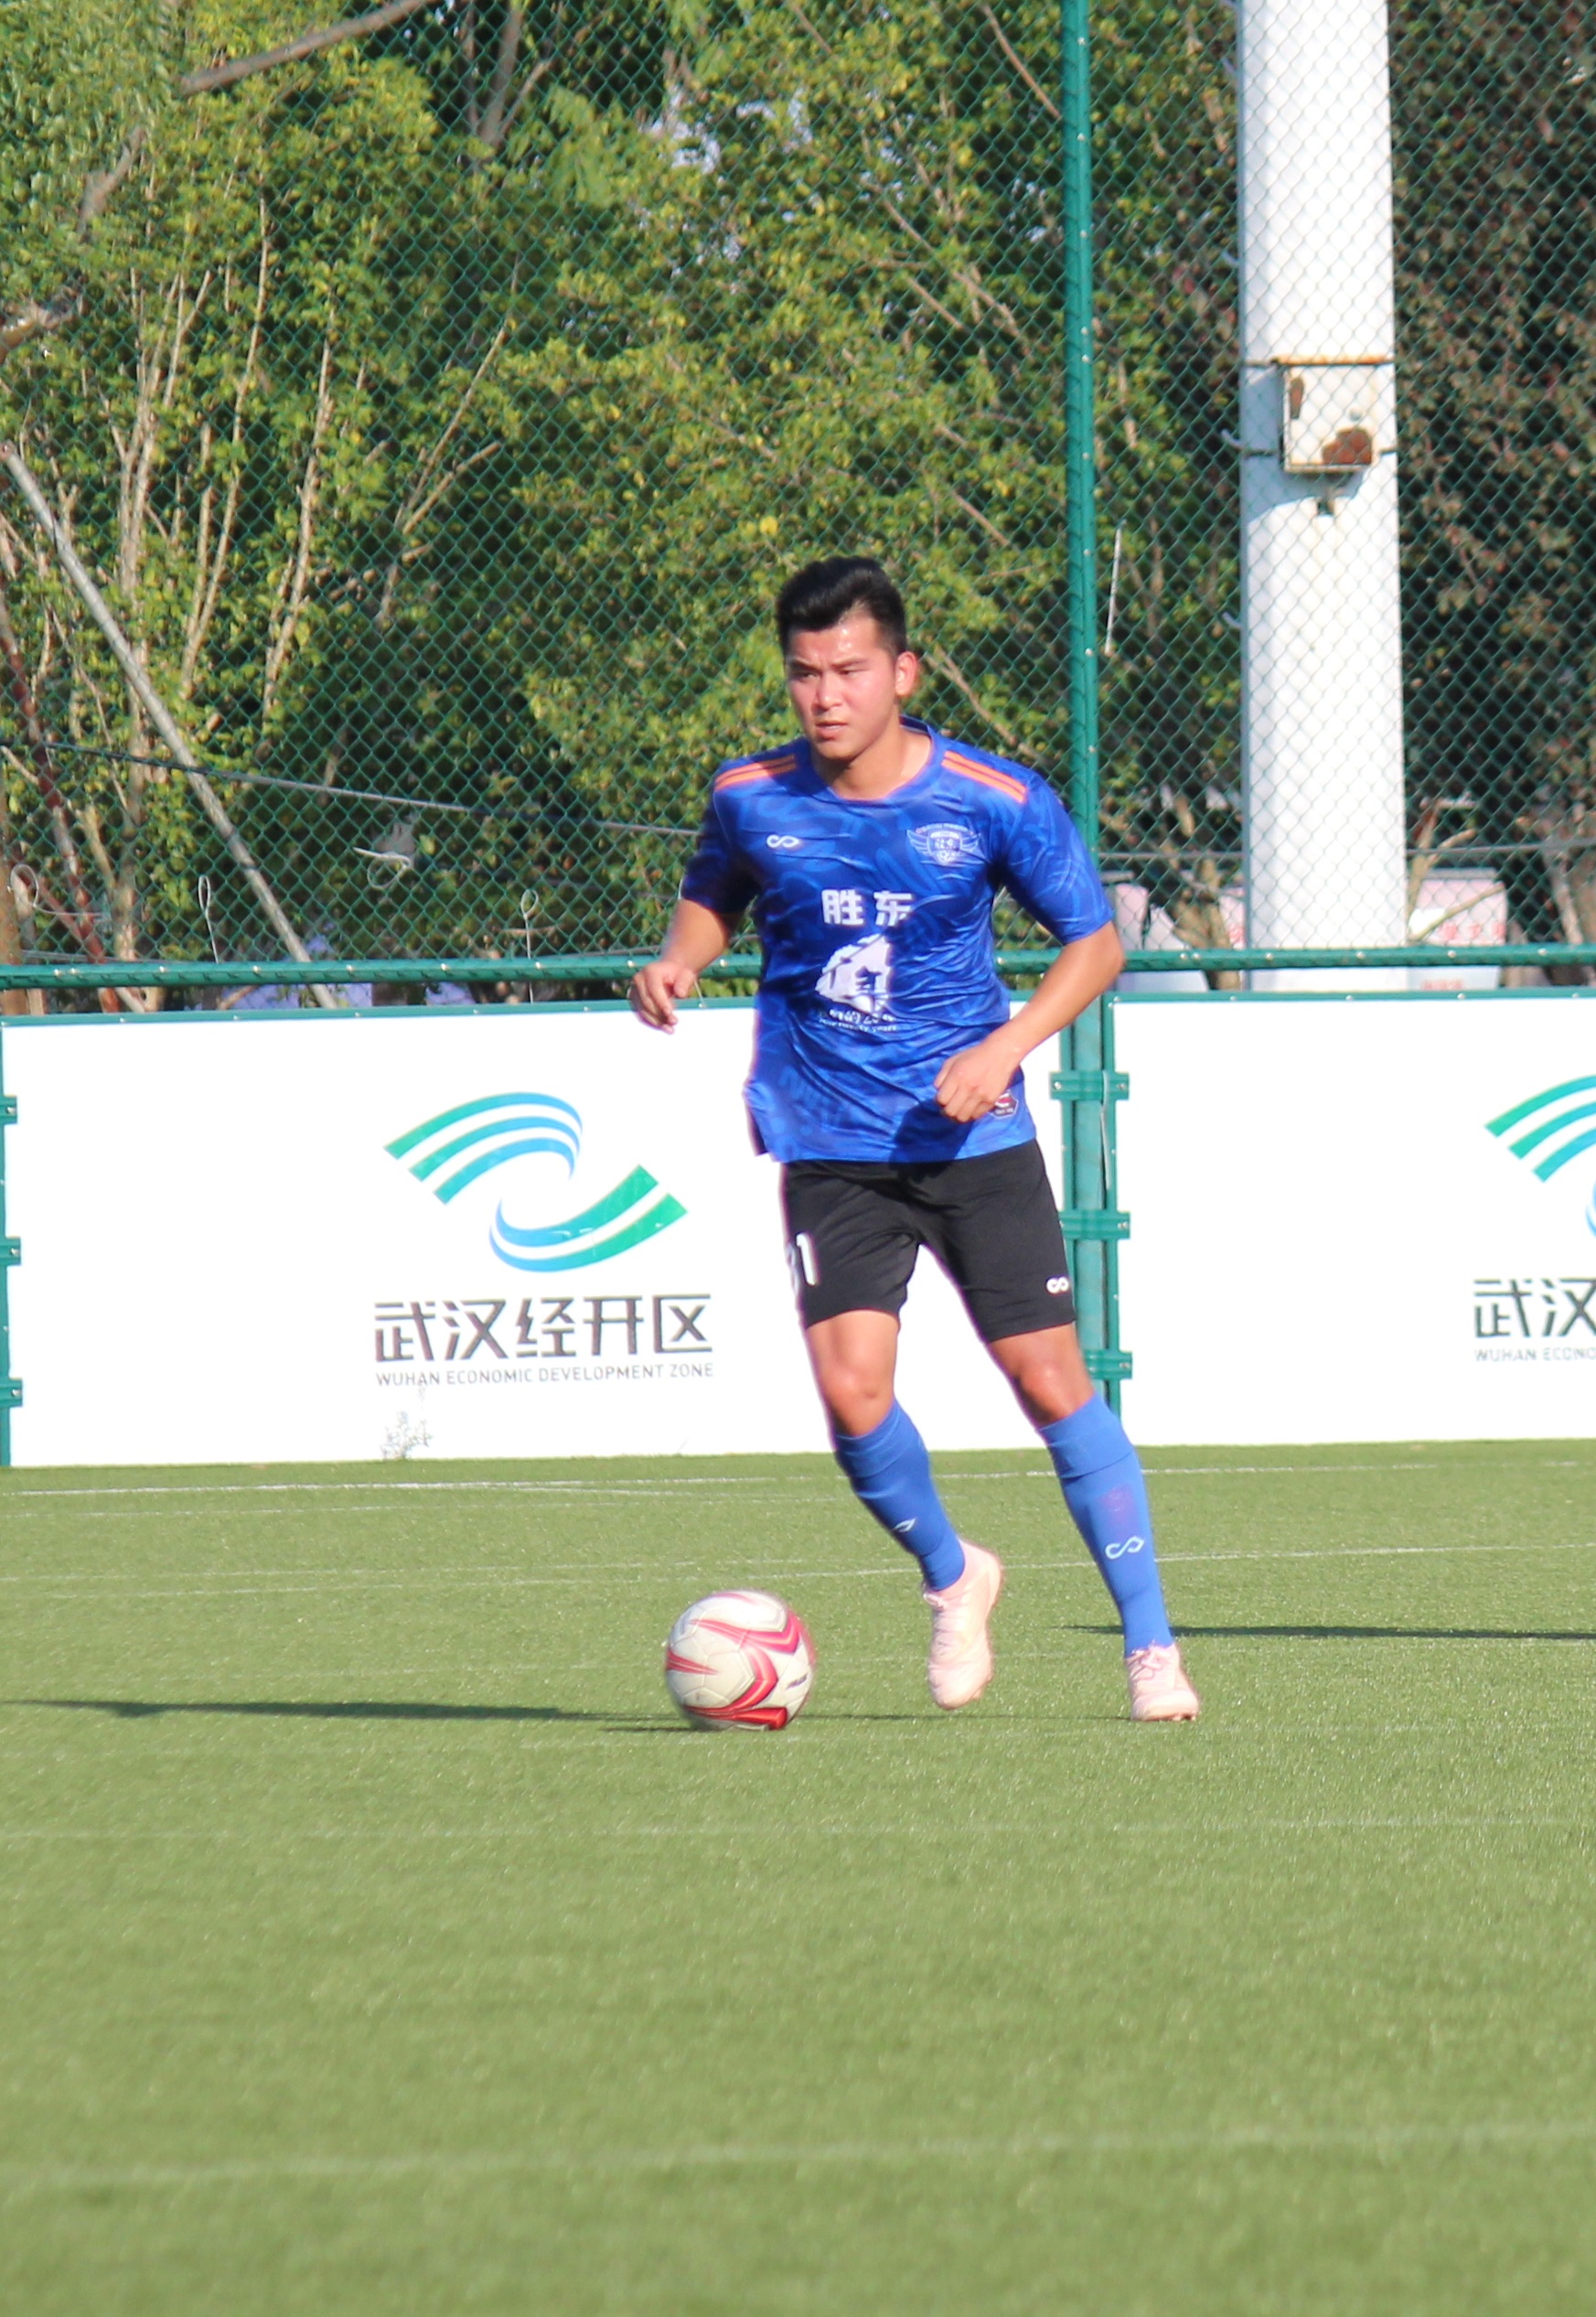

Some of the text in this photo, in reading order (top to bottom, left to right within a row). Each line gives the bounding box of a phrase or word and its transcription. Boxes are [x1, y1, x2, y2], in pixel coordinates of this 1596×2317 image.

[821, 889, 913, 927] 胜东
[374, 1293, 713, 1362] 武汉经开区
[1474, 1348, 1537, 1362] WUHAN
[376, 1362, 714, 1387] WUHAN ECONOMIC DEVELOPMENT ZONE
